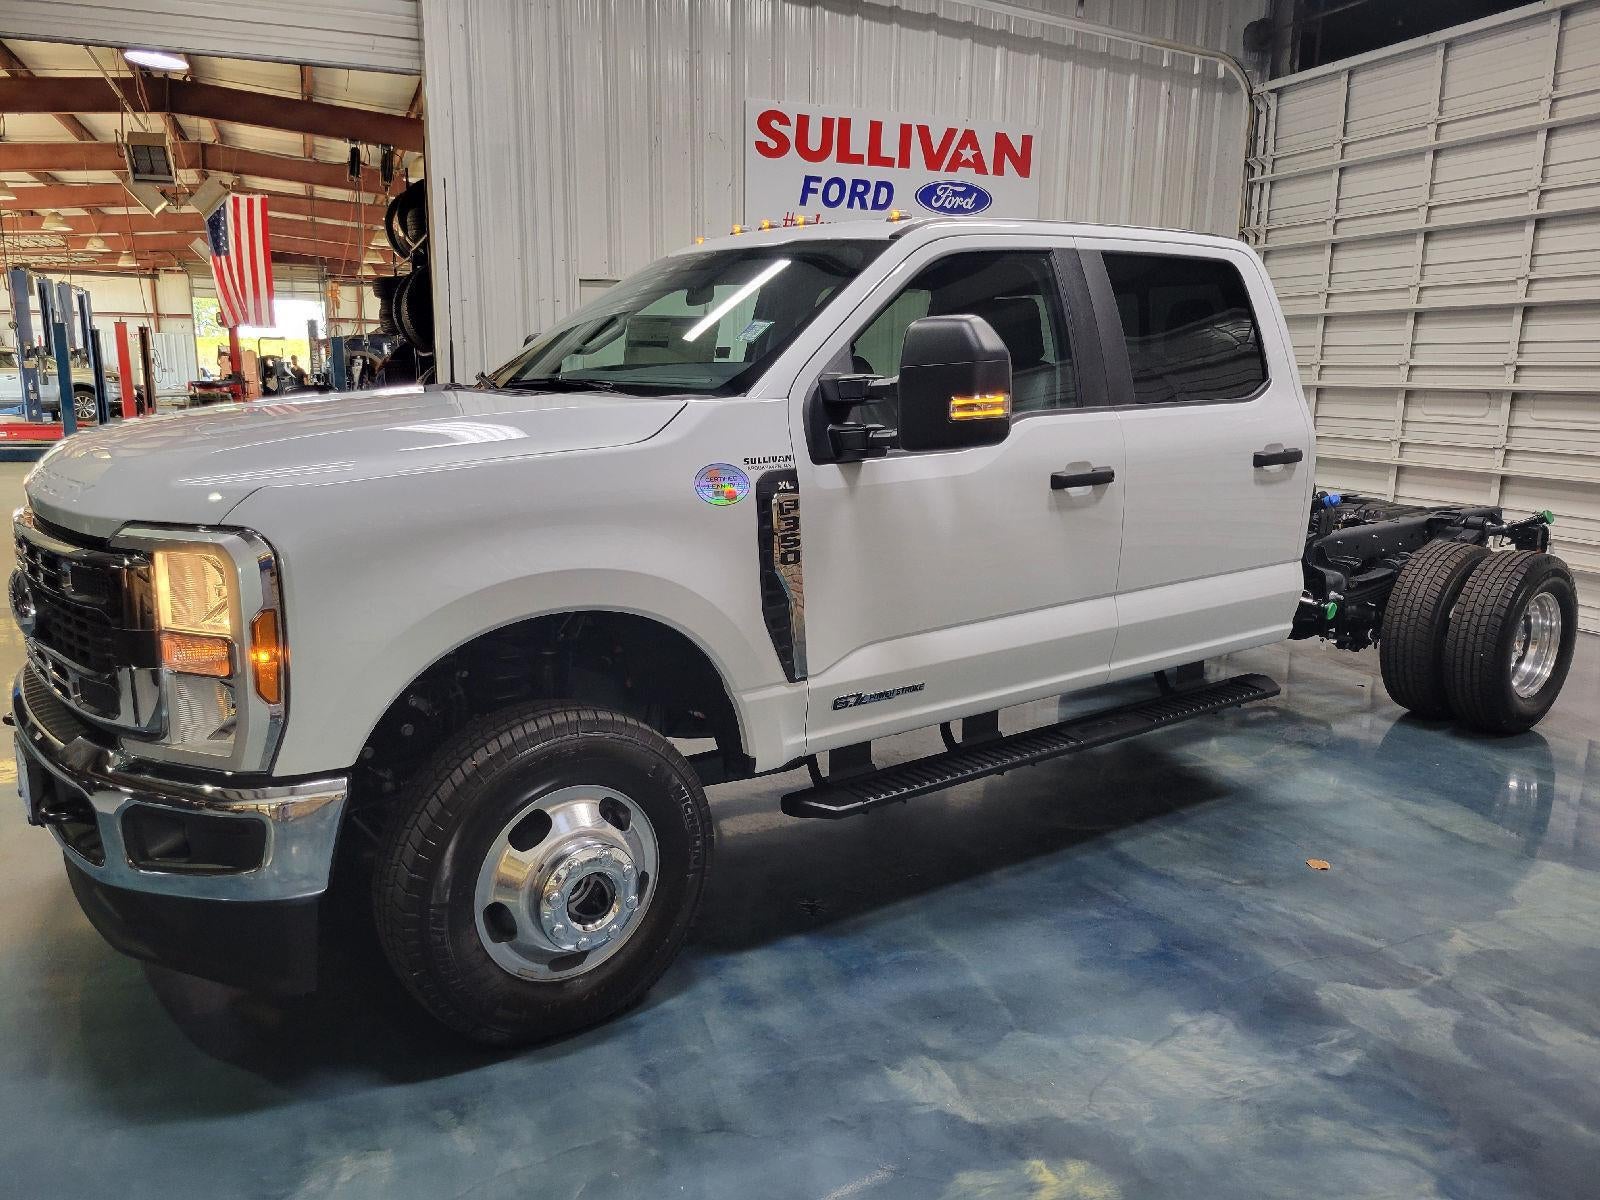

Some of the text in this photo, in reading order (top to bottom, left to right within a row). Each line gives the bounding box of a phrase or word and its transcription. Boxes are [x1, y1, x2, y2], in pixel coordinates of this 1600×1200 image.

[754, 109, 1034, 179] SULLIVAN
[799, 174, 978, 211] FORD Ford
[743, 454, 792, 466] SULLIVAN
[778, 480, 795, 491] XL
